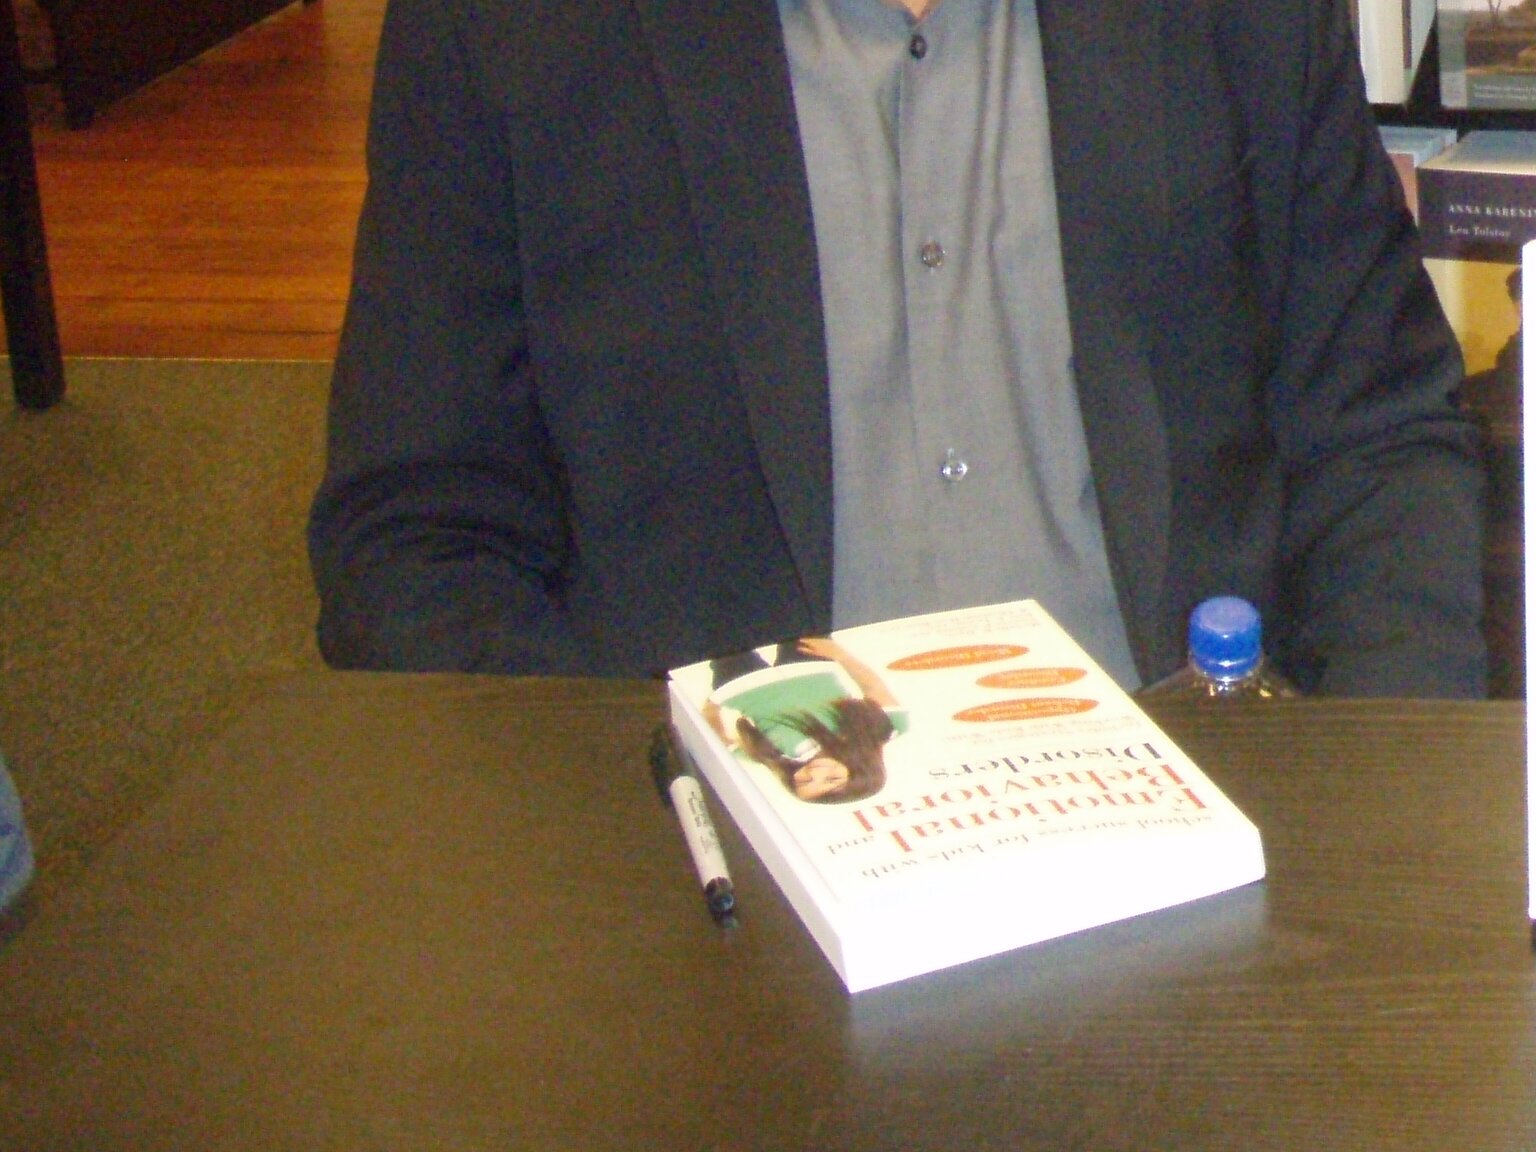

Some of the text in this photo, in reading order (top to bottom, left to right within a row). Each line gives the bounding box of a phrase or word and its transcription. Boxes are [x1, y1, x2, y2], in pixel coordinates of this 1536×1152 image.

[1448, 204, 1482, 218] ANNA
[1448, 224, 1511, 241] Leo Tolstoy
[927, 741, 1163, 782] Disorders
[851, 764, 1187, 834] Behavioral
[826, 788, 1210, 857] Emotional and
[1136, 815, 1214, 833] school
[928, 840, 982, 864] kids
[993, 832, 1031, 852] for
[860, 853, 919, 881] with
